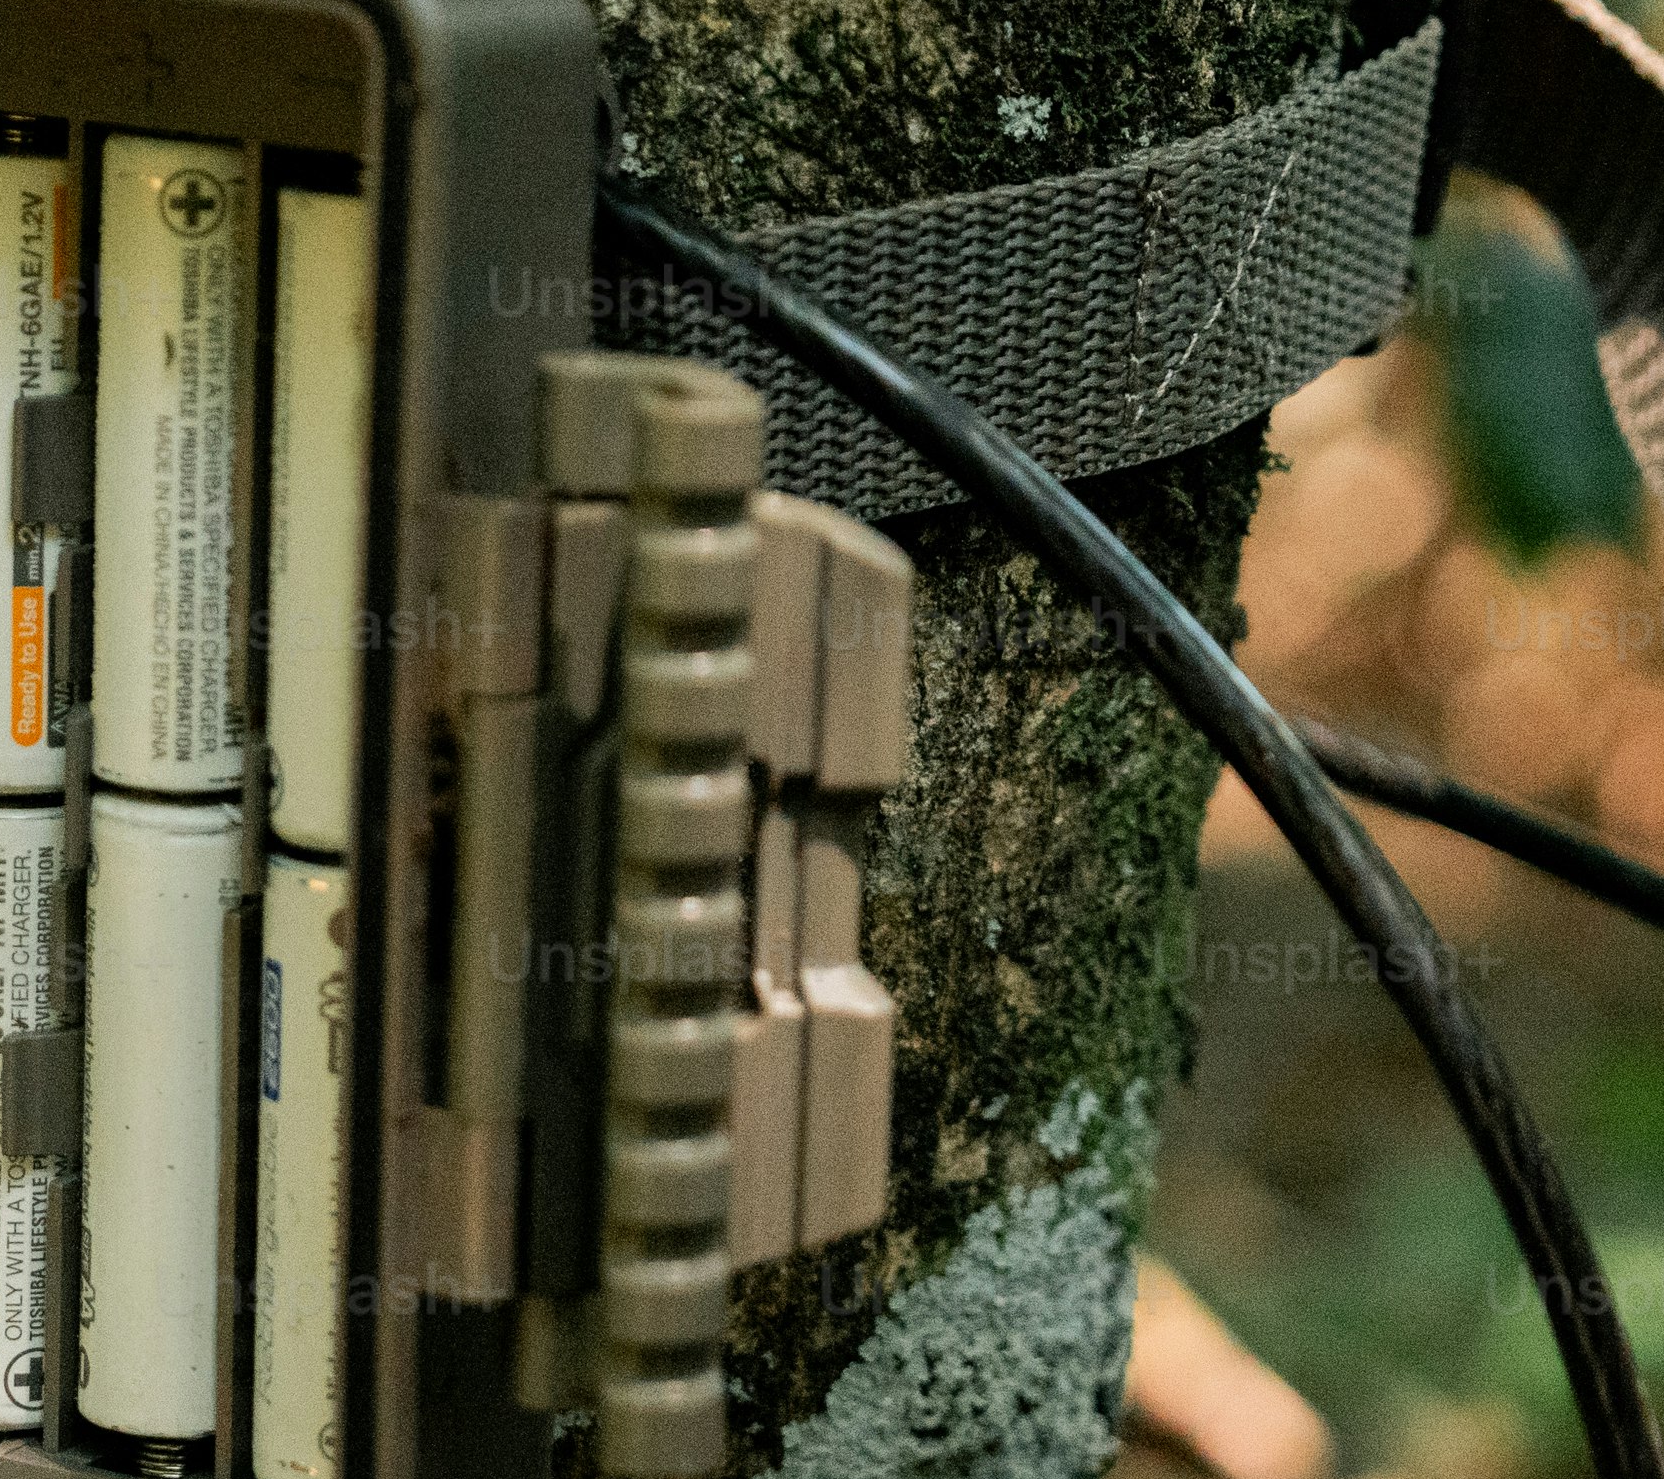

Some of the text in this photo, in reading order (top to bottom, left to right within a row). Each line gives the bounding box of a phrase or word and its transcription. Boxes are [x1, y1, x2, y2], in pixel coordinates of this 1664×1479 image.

[182, 247, 201, 322] TOSHIBA
[179, 328, 199, 418] LIFESTYLE
[156, 415, 172, 474] MADE
[179, 426, 197, 521] PRODUCTS
[203, 404, 223, 507] TOSHIBA
[155, 481, 171, 501] IN
[177, 548, 195, 631] SERVICES
[201, 513, 222, 633] SPECIFIED
[19, 597, 37, 636] Use
[19, 644, 37, 663] to
[18, 670, 40, 734] Ready
[151, 695, 169, 760] CHINA
[176, 638, 194, 762] CORPORATION
[11, 849, 32, 966] CHARGER.
[35, 846, 54, 1031] RVICES CORPORATION
[6, 1198, 25, 1213] A
[30, 1177, 48, 1262] LIFESTYLE
[5, 1220, 25, 1277] WITH
[4, 1283, 24, 1341] ONLY
[29, 1267, 46, 1341] TOSHIBA
